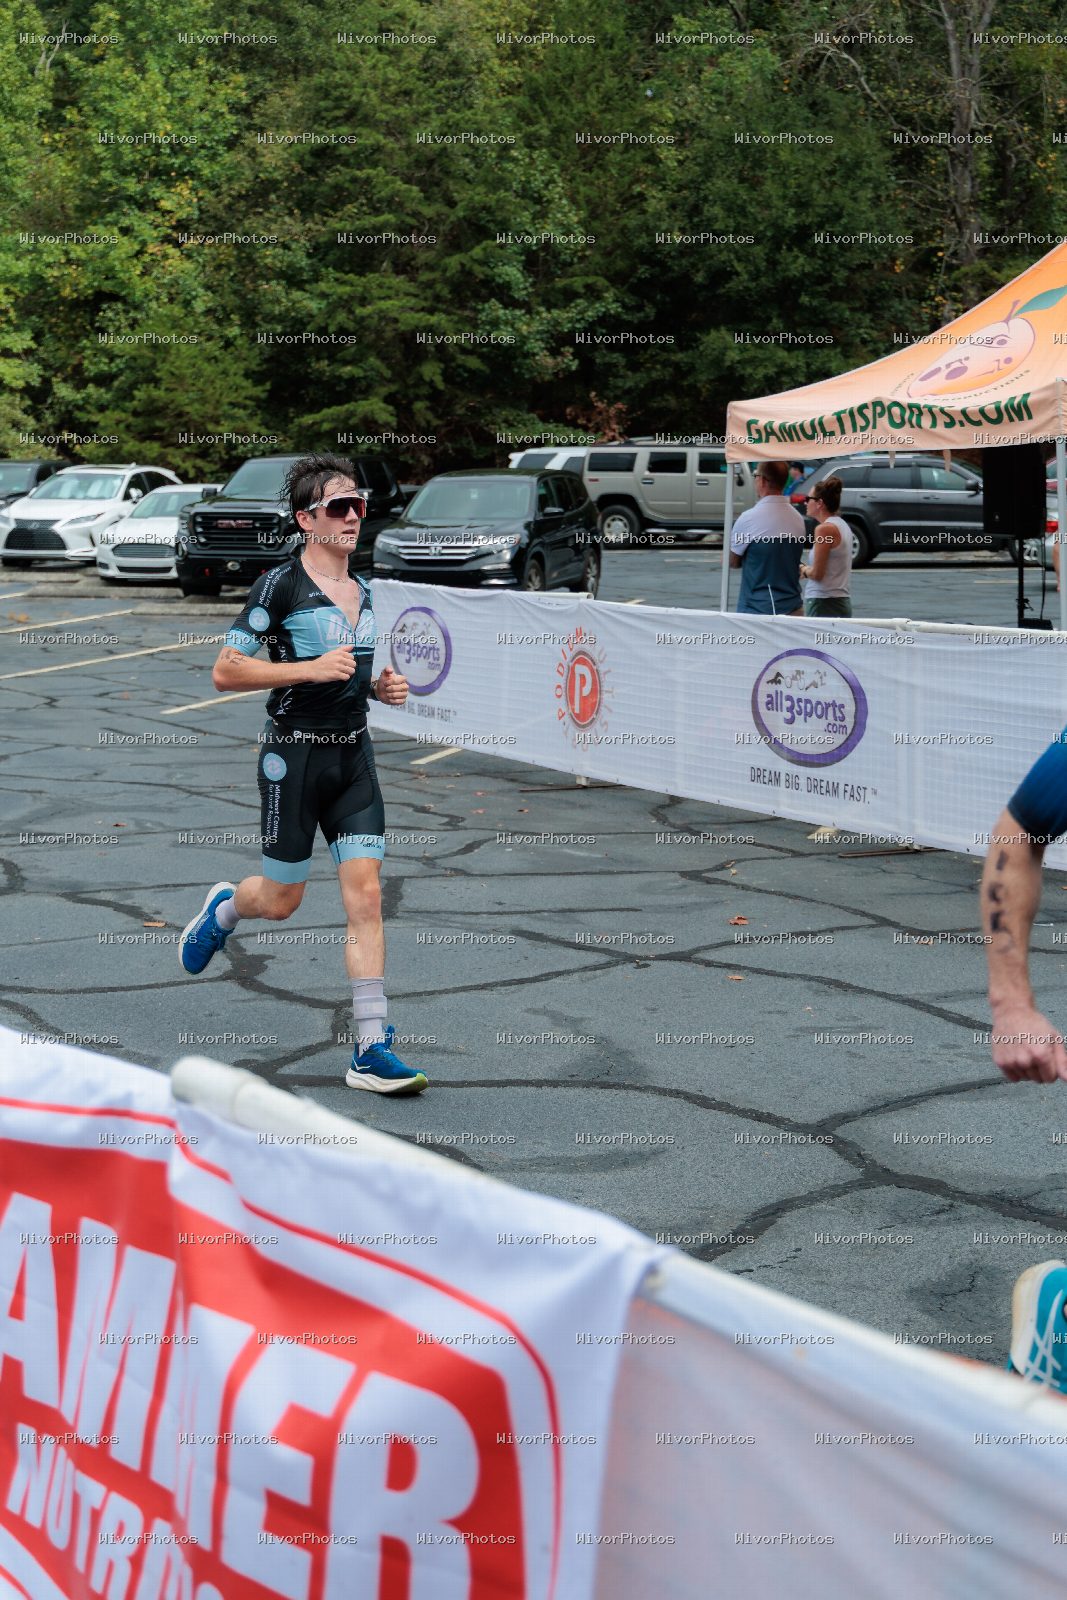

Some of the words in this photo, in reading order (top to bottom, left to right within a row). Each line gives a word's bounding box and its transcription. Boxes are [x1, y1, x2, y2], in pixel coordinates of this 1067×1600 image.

[746, 393, 1034, 444] GAMULTISPORTS.COM
[765, 690, 846, 725] all3sports
[824, 721, 848, 736] .com
[750, 766, 781, 787] DREAM
[785, 772, 803, 792] BIG.
[806, 776, 840, 799] DREAM
